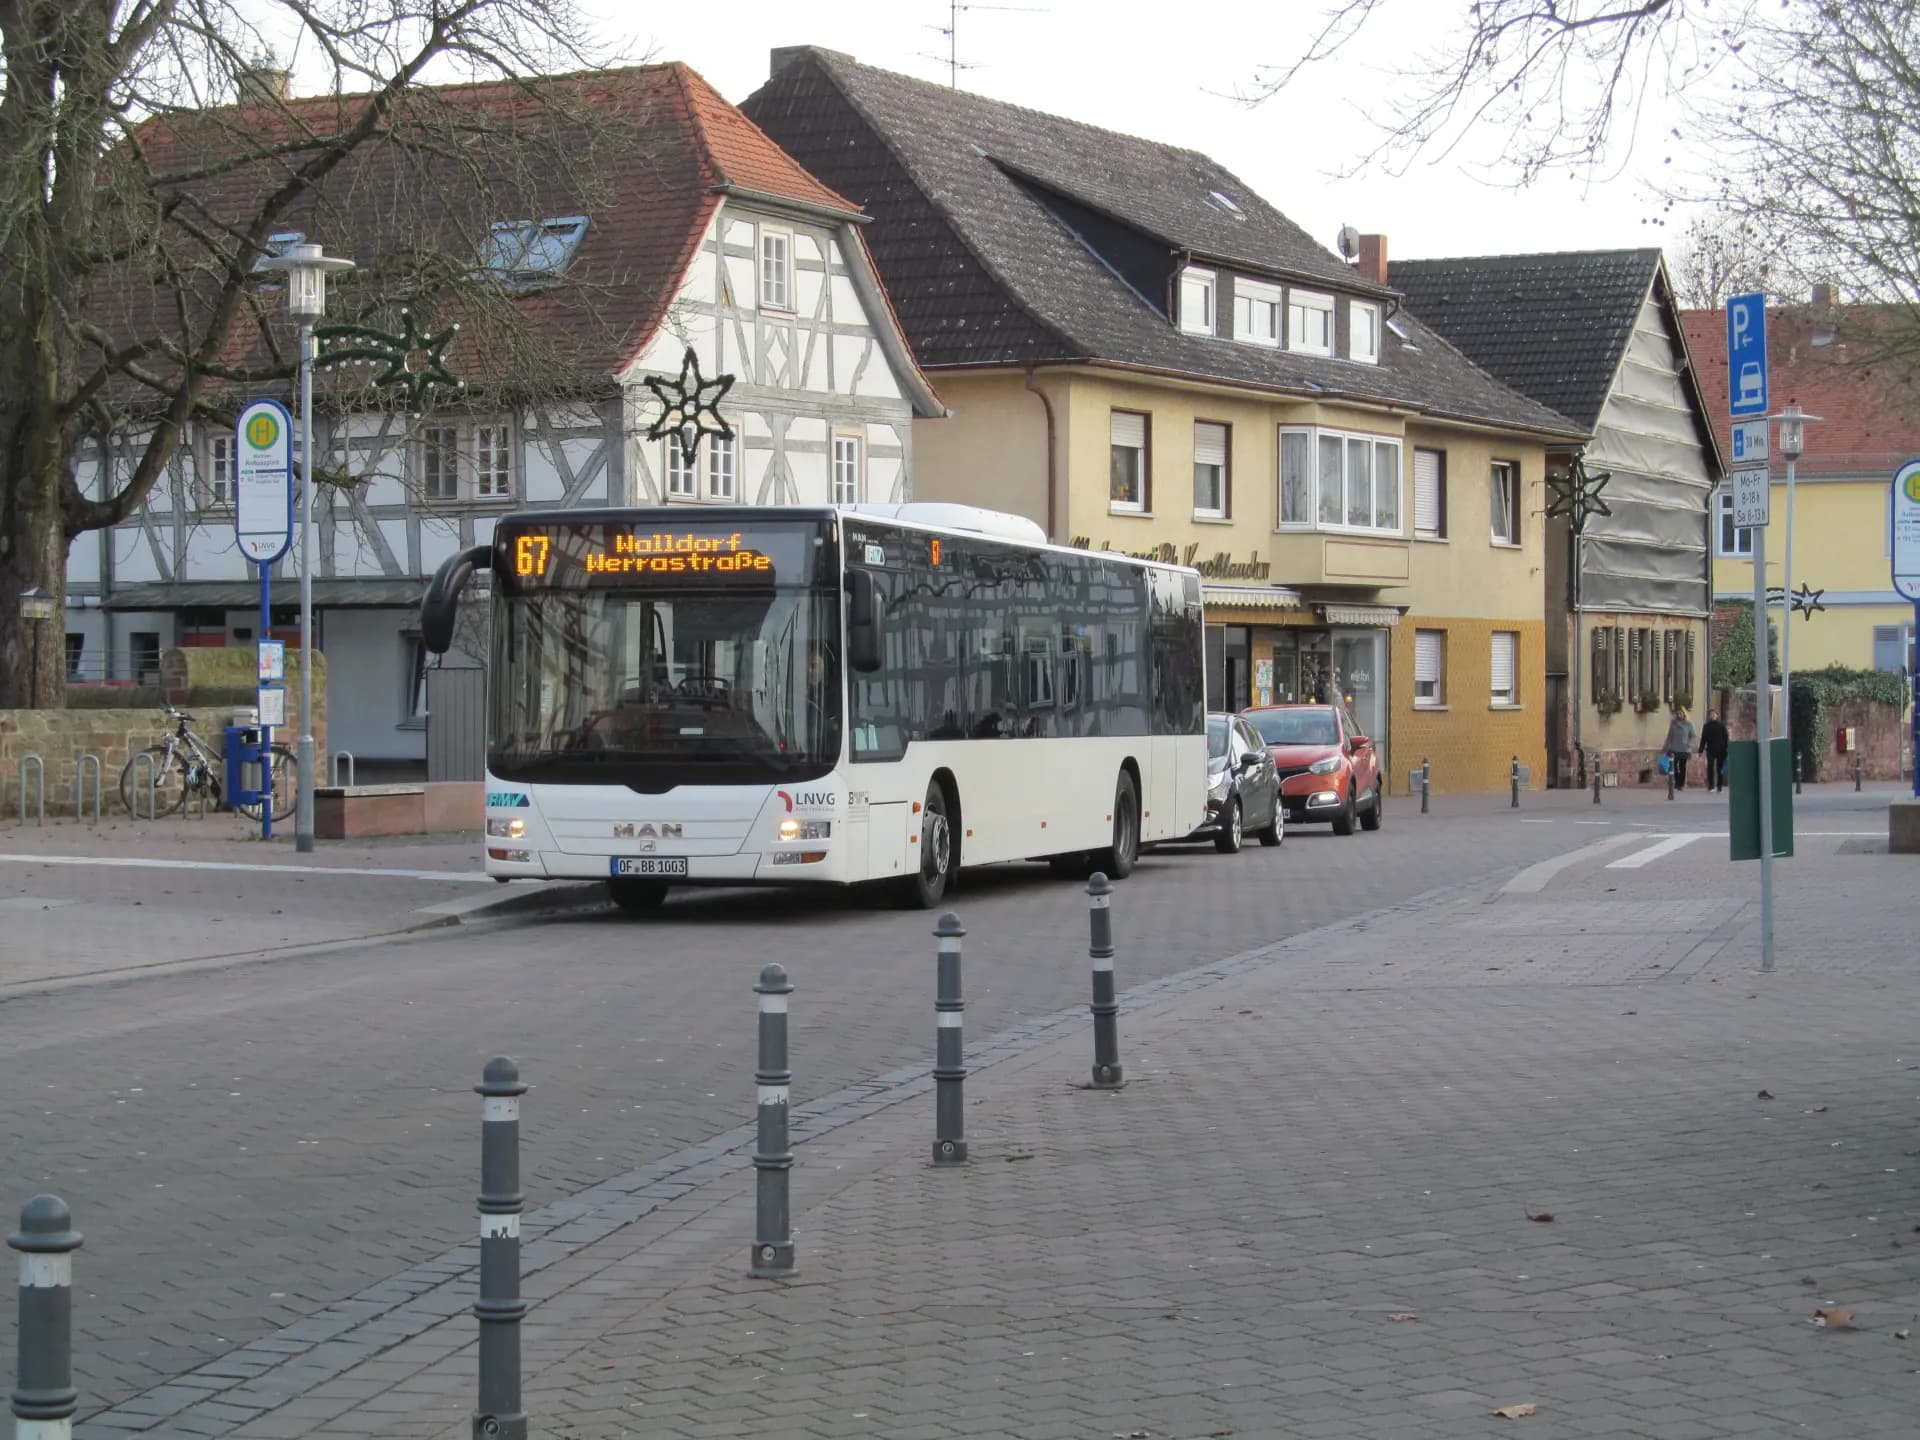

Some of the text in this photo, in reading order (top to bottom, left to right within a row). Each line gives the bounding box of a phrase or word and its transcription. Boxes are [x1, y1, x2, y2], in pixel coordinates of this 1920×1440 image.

[1733, 304, 1749, 350] P
[1740, 473, 1761, 488] Mo-Fr
[1737, 509, 1746, 522] Sa
[616, 533, 742, 553] Walldorf
[517, 536, 549, 575] 67
[586, 551, 771, 572] Werrastraße
[796, 792, 836, 806] LNVG
[613, 823, 683, 838] MAN
[620, 860, 685, 873] OF BB 1003
